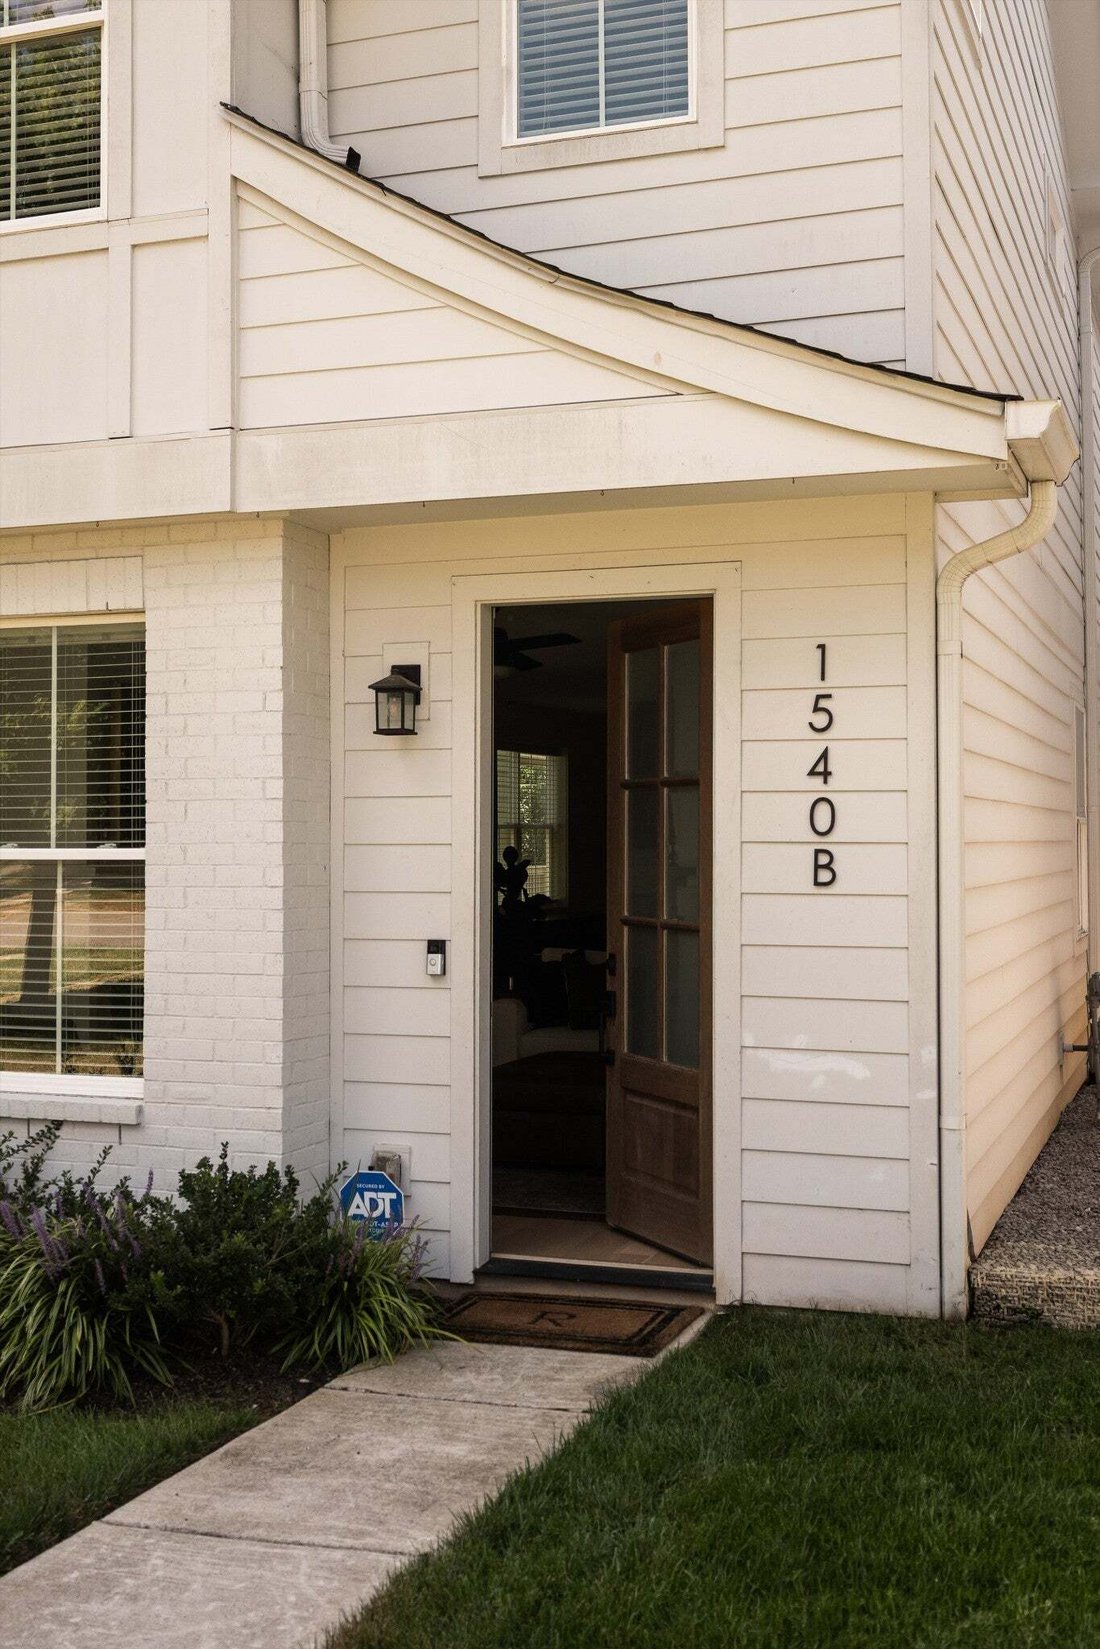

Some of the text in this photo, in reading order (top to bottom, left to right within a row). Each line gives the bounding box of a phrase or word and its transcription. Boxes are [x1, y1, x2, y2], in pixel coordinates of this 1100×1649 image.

[806, 643, 837, 887] 1540B
[347, 1191, 397, 1219] ADT
[528, 1311, 577, 1328] R
